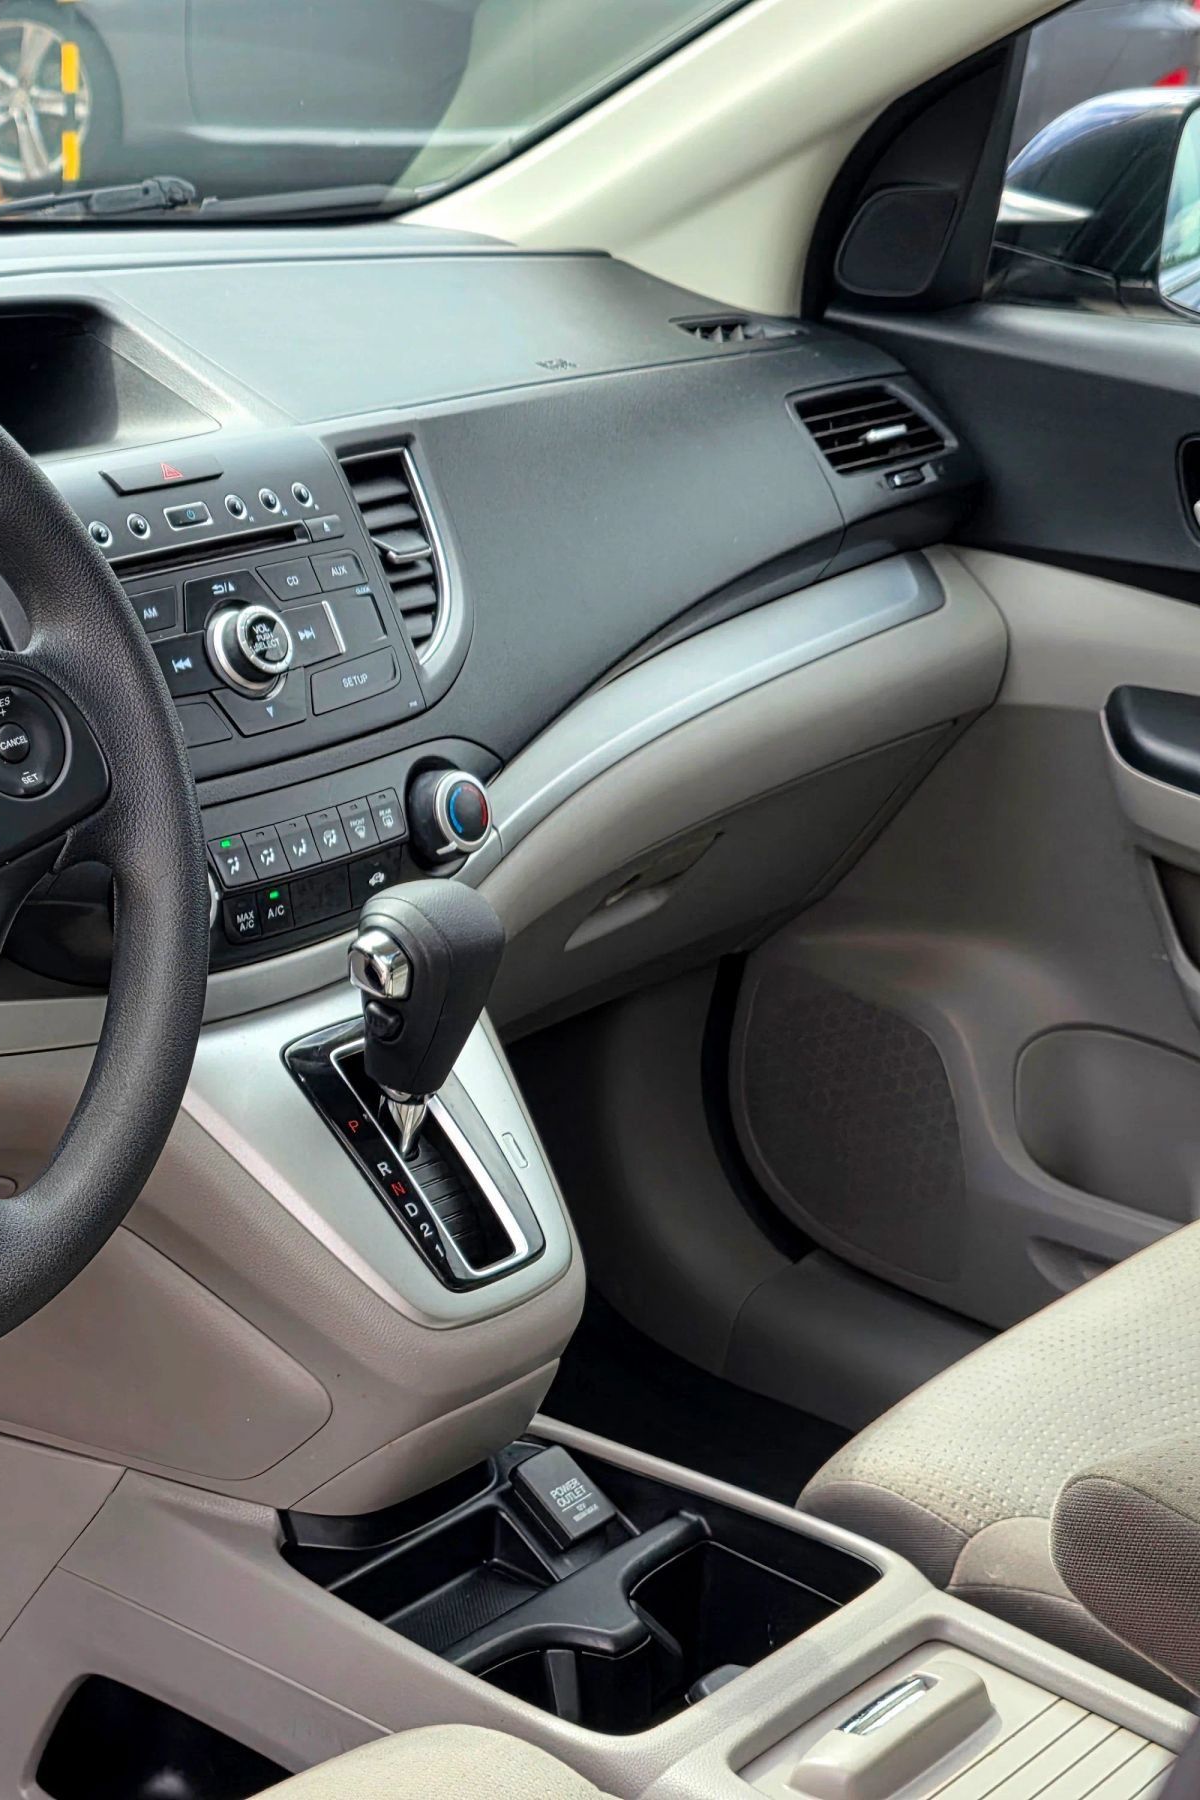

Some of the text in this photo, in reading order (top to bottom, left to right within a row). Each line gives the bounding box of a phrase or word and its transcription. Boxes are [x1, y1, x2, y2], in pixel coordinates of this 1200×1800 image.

[331, 565, 348, 577] AUX
[286, 575, 299, 586] CD
[143, 605, 159, 620] AM
[252, 623, 270, 634] VOL
[342, 672, 368, 688] SETUP
[0, 735, 28, 750] CANCEL
[21, 773, 39, 785] SET
[236, 909, 255, 924] MAX
[267, 904, 285, 919] A/C
[240, 919, 255, 932] A/C
[347, 1119, 361, 1134] P
[377, 1161, 392, 1178] R
[390, 1181, 406, 1197] N
[404, 1202, 419, 1218] D
[419, 1222, 433, 1238] 2
[435, 1243, 445, 1258] 1
[550, 1478, 580, 1499] POWER
[557, 1485, 586, 1507] OUTLET
